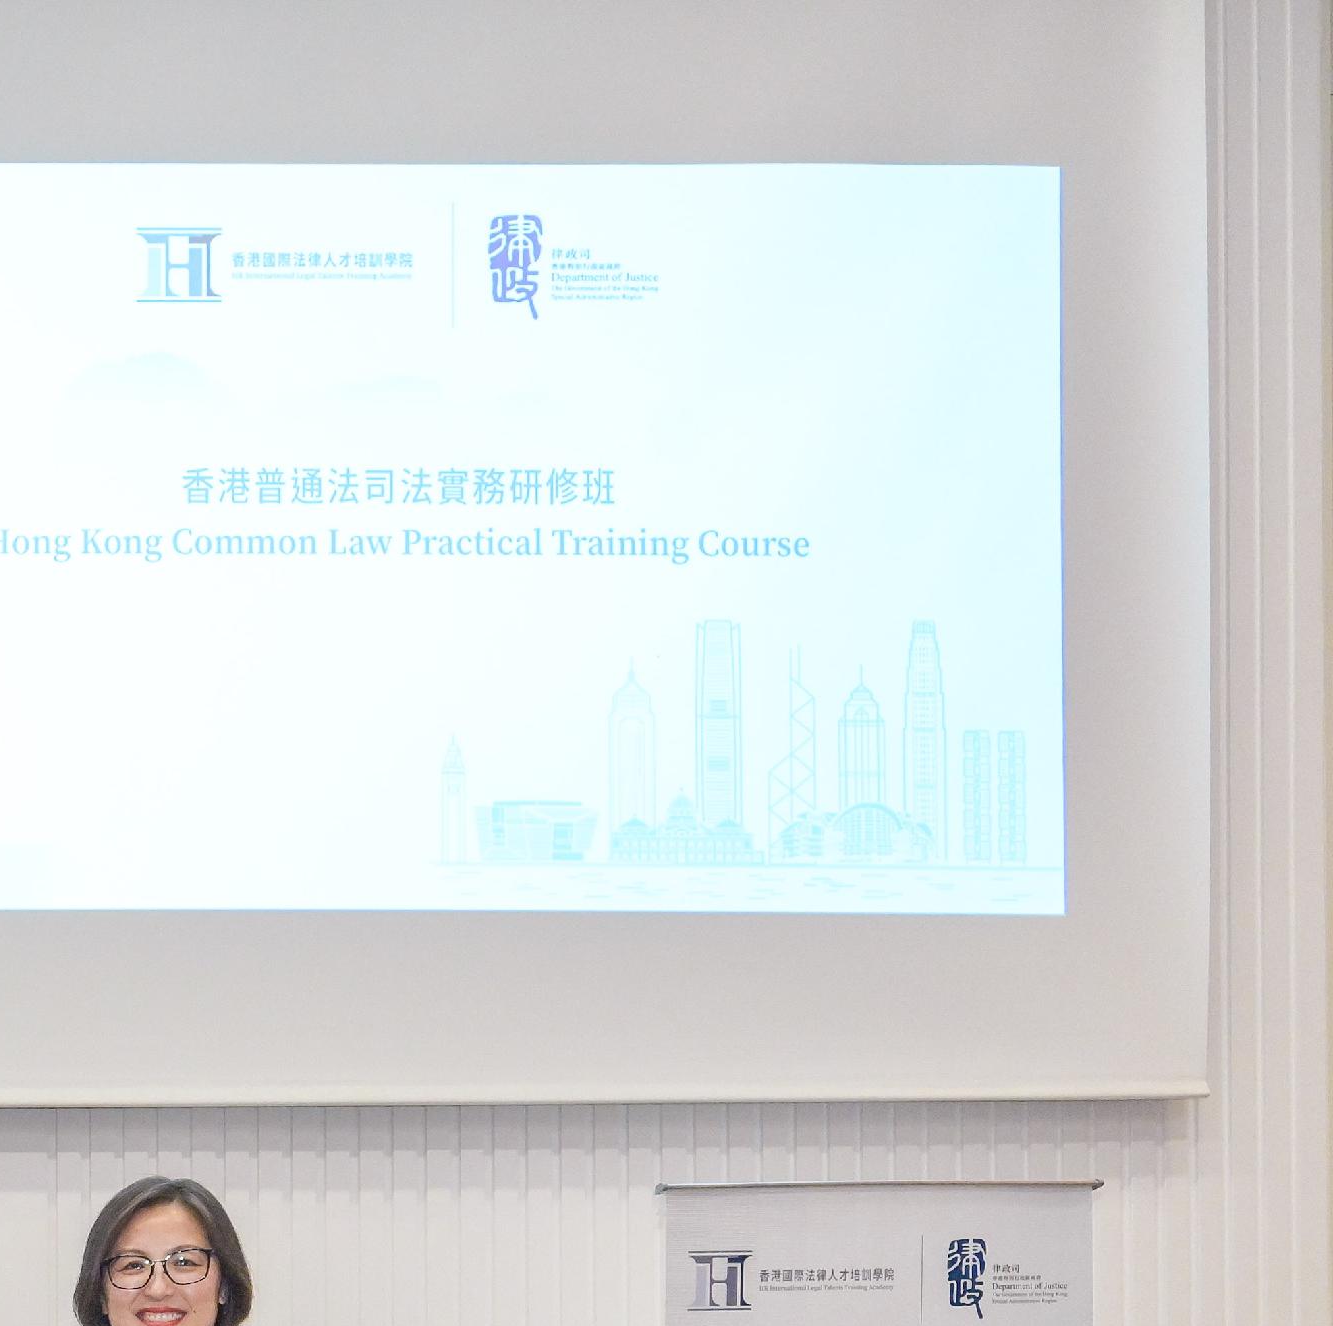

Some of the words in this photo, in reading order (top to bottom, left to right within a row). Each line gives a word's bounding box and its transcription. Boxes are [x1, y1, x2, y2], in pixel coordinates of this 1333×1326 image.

[232, 251, 414, 268] 香港國際法律人才培訓學院
[551, 272, 608, 283] Department
[612, 272, 623, 282] of
[626, 272, 660, 282] Justice
[182, 467, 615, 506] 香港普通法司法實務研修班
[82, 529, 162, 562] Kong
[172, 528, 317, 555] Common
[330, 529, 392, 556] Law
[403, 527, 542, 556] Practical
[551, 528, 690, 565] Training
[698, 529, 811, 558] Course
[759, 1268, 895, 1283] 香港國際法律人才培訓學院
[992, 1282, 1033, 1291] Department
[1044, 1282, 1068, 1290] Justice
